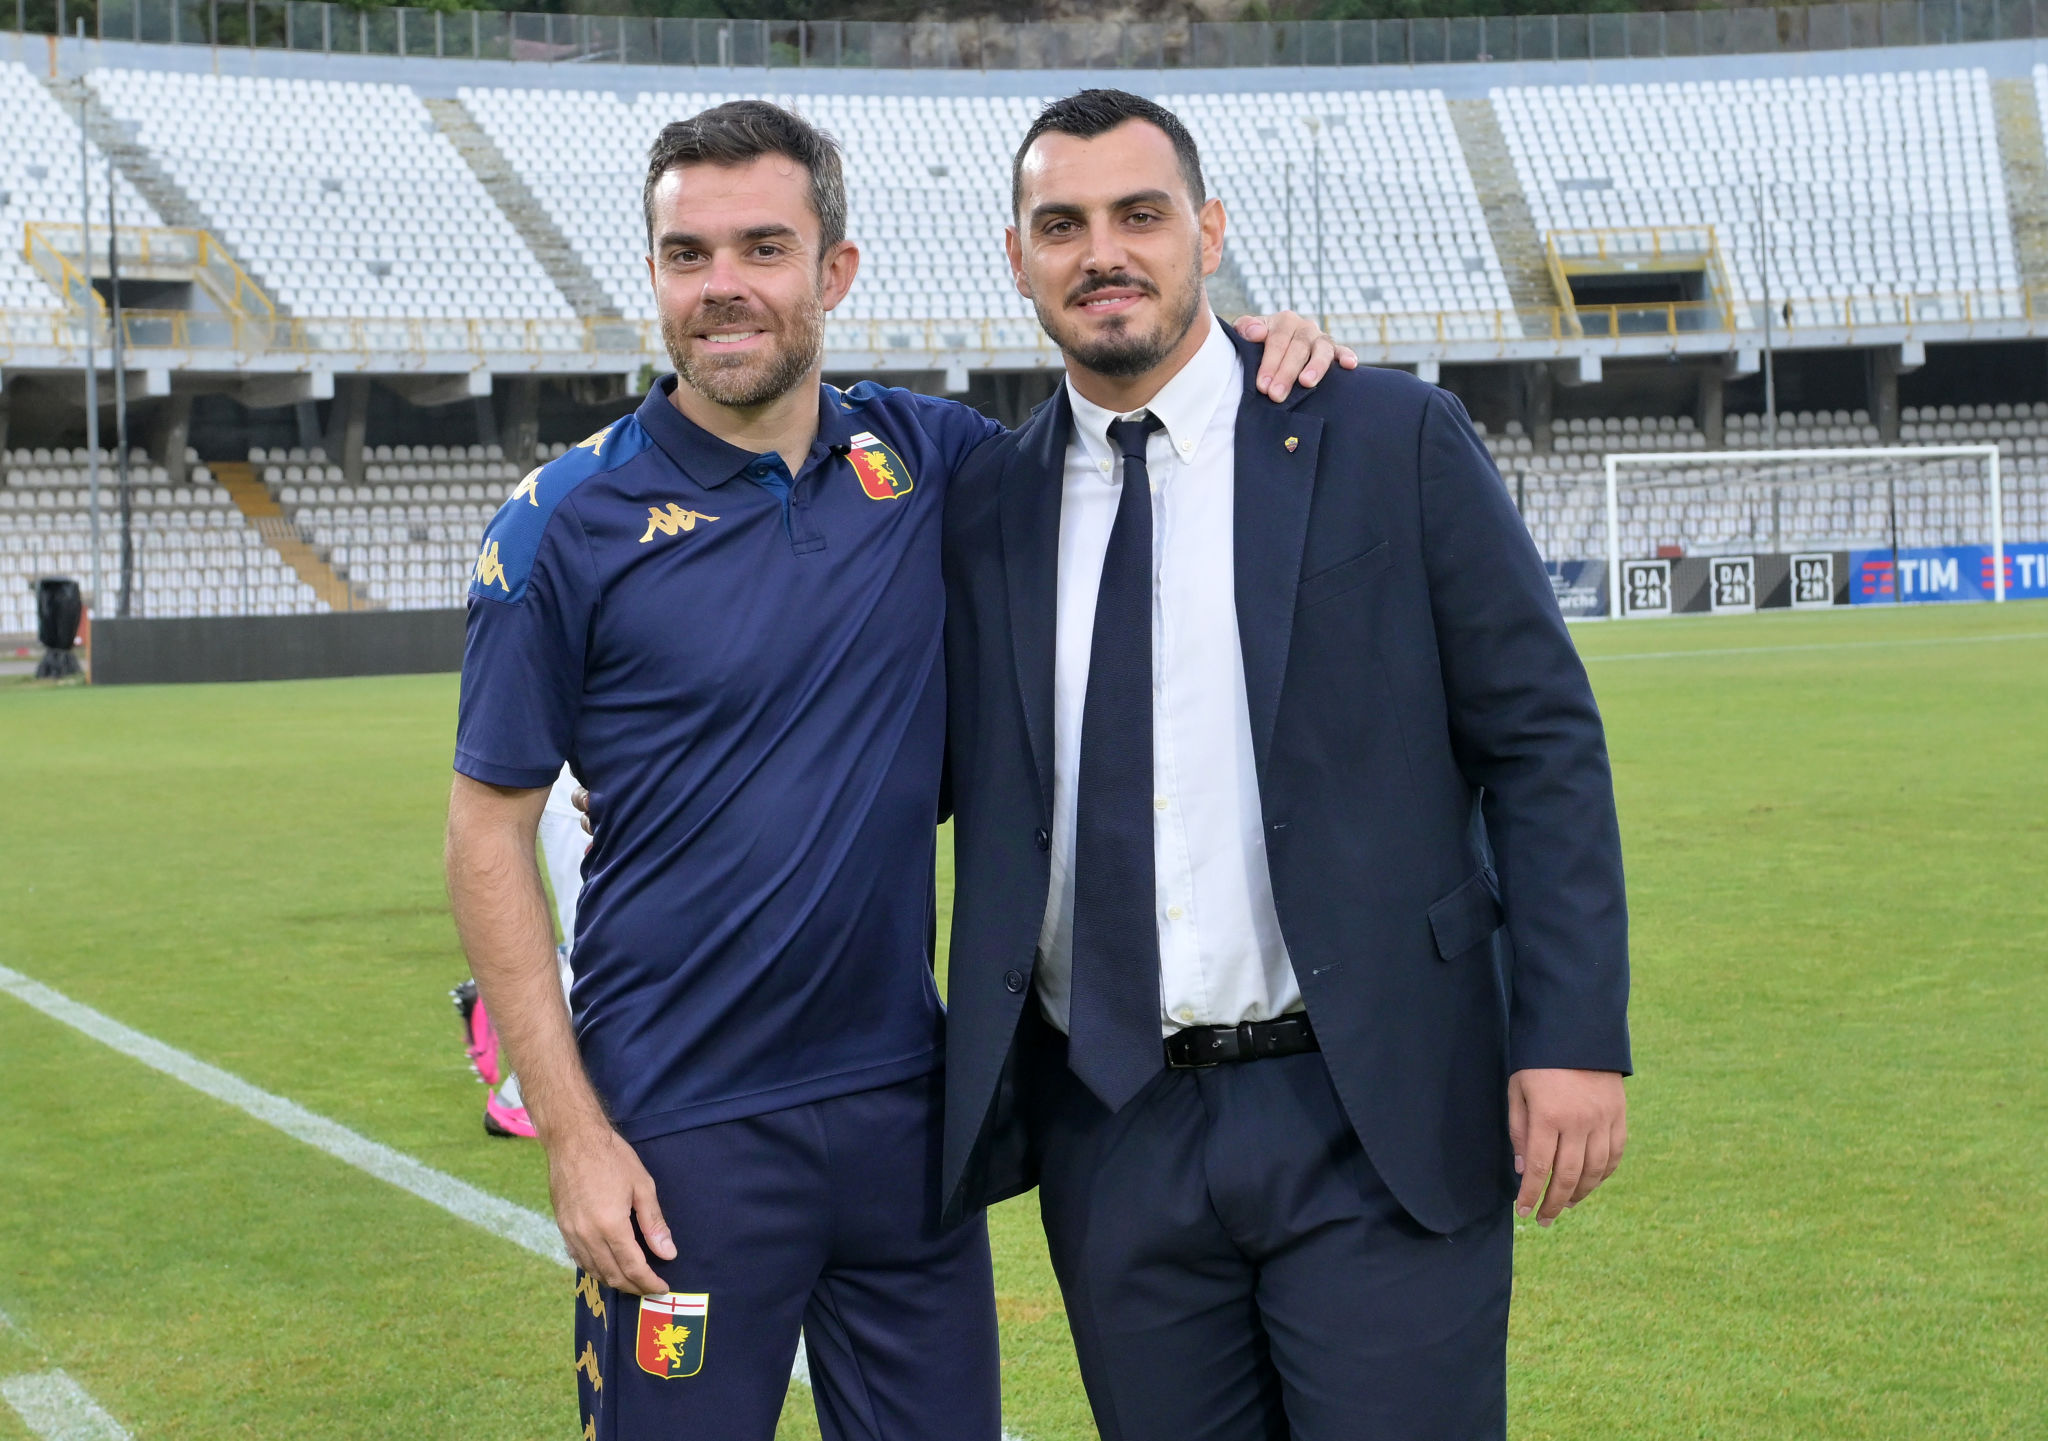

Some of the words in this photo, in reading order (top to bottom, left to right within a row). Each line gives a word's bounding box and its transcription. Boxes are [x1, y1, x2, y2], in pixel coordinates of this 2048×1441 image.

[1634, 569, 1661, 588] DA
[1720, 564, 1746, 584] DA
[1800, 561, 1825, 580] DA
[1897, 557, 1958, 594] TIM
[2016, 554, 2048, 589] TI
[1634, 588, 1662, 608] ZN
[1720, 584, 1746, 603] ZN
[1800, 580, 1825, 600] ZN
[1558, 593, 1598, 608] arche
